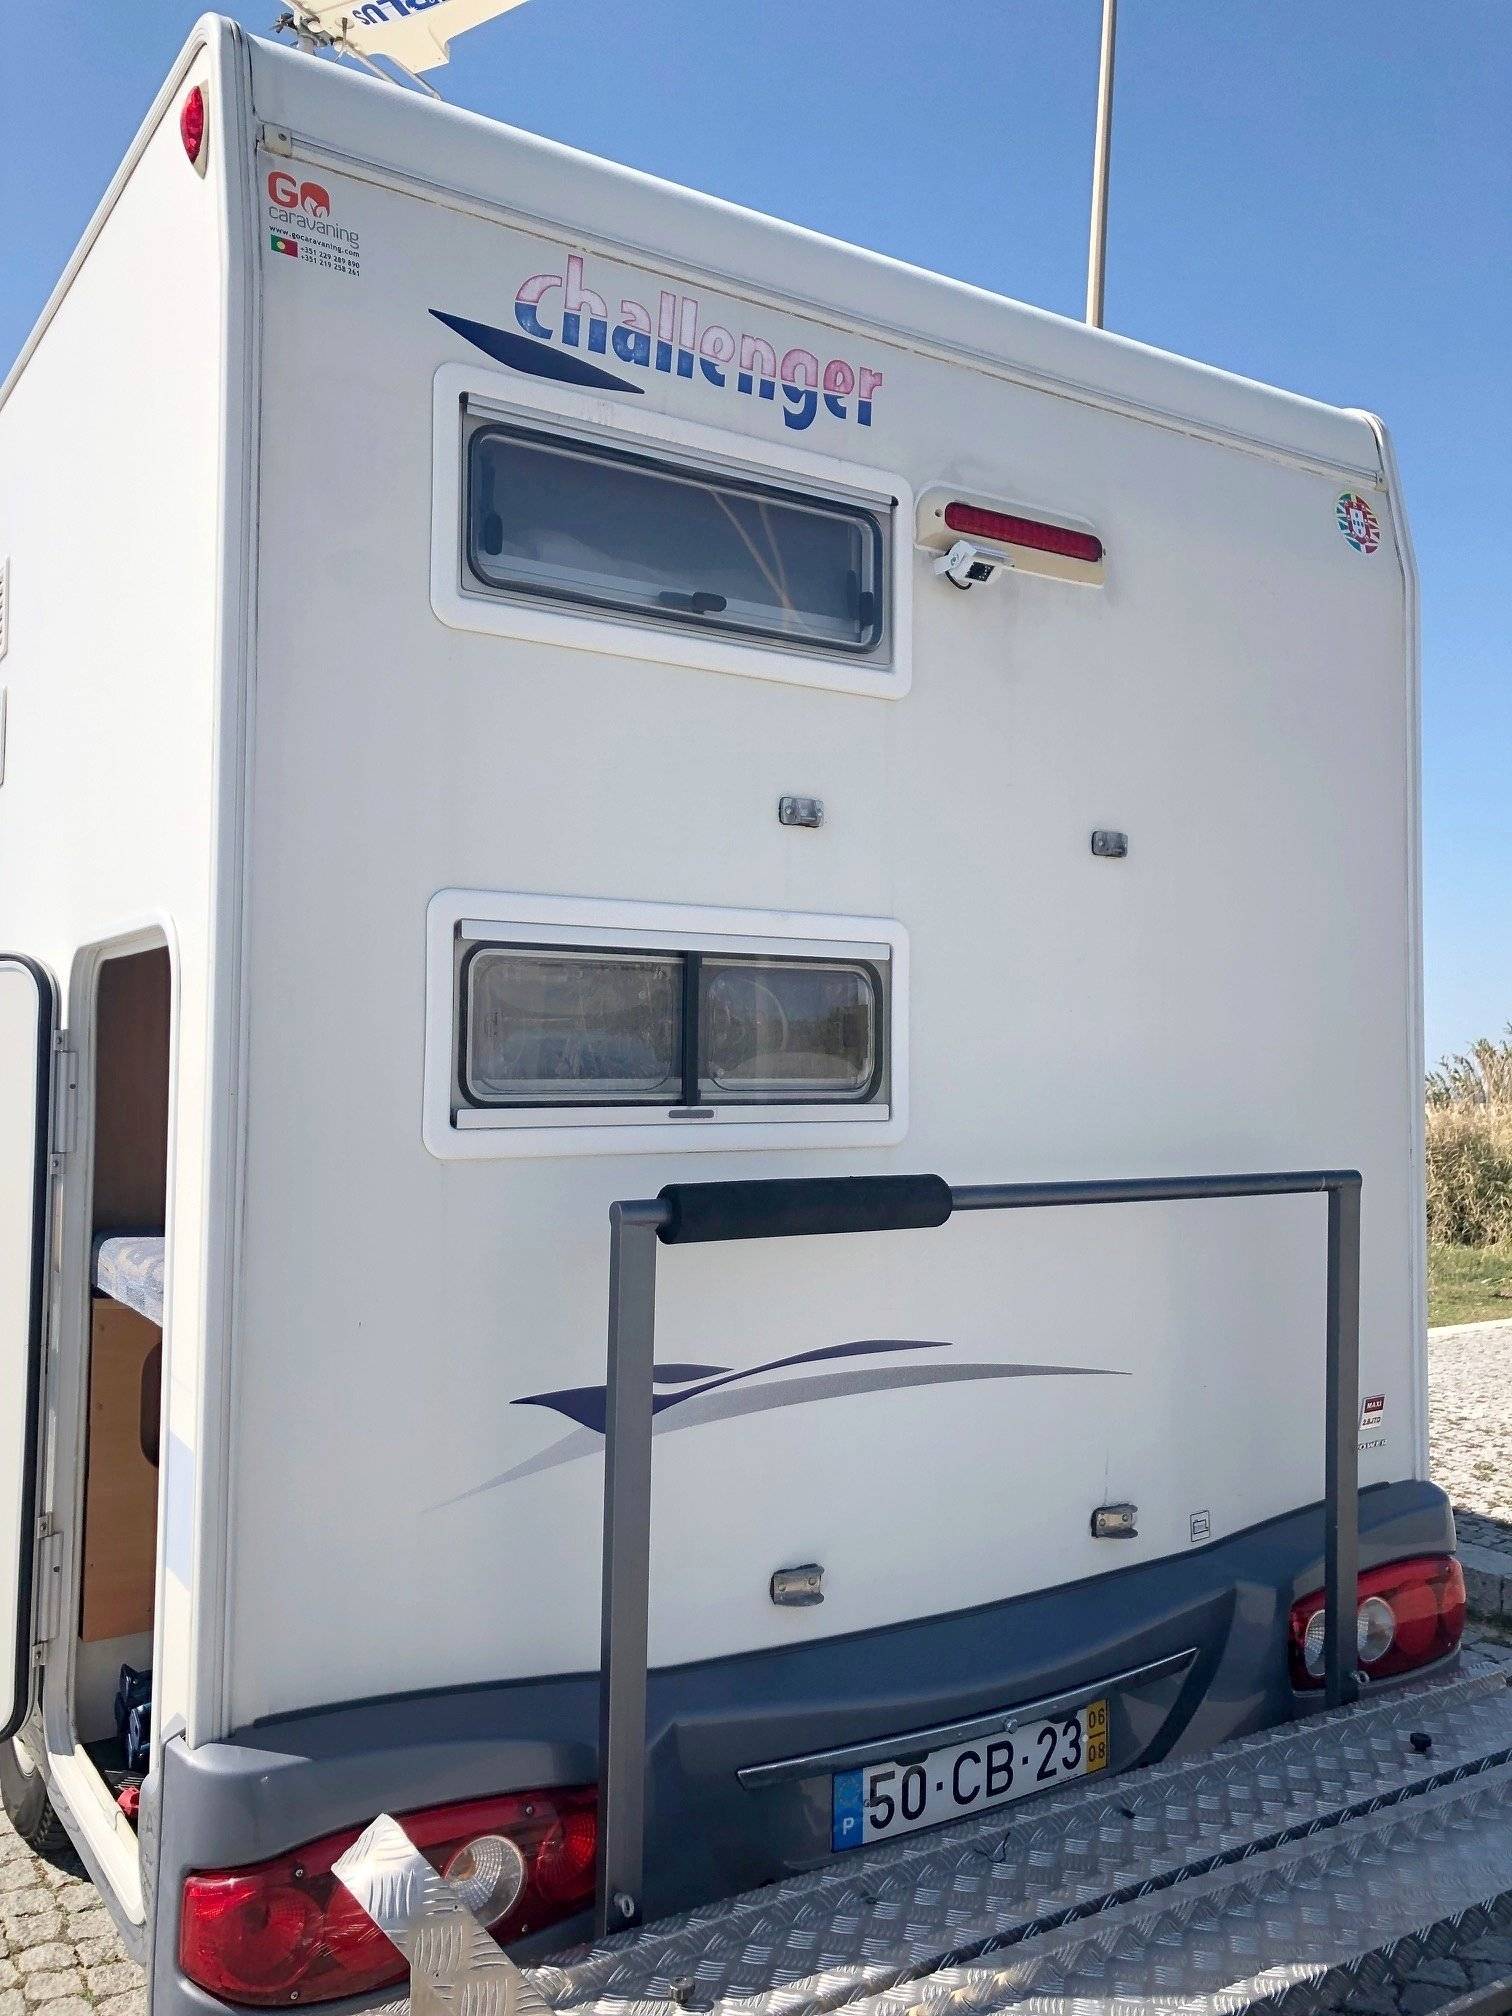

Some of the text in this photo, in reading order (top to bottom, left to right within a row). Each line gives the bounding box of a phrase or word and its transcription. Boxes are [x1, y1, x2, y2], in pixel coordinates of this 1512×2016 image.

[267, 171, 330, 218] GO
[268, 206, 360, 250] caravaning
[269, 225, 360, 258] www.gocaravaning.com
[300, 246, 317, 256] +351
[319, 251, 332, 260] 229
[347, 260, 360, 269] 890
[300, 254, 317, 264] +351
[319, 259, 332, 268] 219
[515, 254, 883, 431] challenger
[1358, 1439, 1387, 1450] OWER
[1088, 1708, 1105, 1729] 06
[1088, 1742, 1106, 1763] 08
[842, 1817, 855, 1836] P
